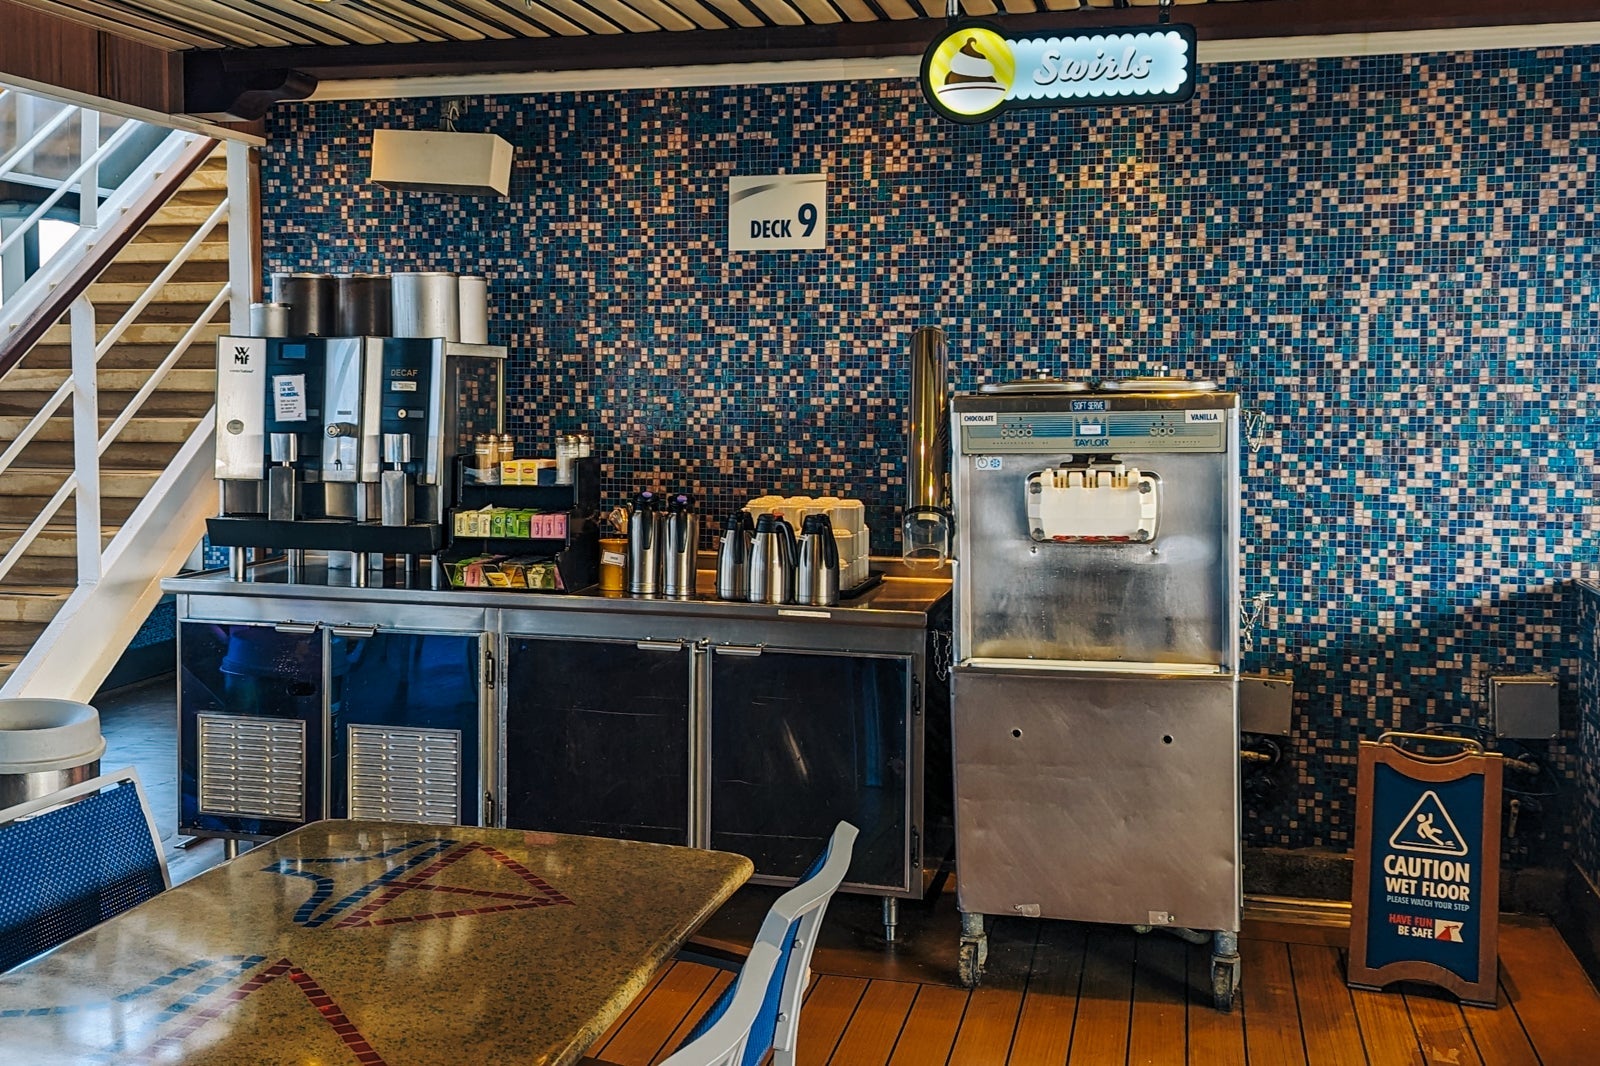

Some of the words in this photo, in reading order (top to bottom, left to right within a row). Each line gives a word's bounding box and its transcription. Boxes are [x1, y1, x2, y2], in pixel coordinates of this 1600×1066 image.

[1032, 45, 1153, 86] Swirls
[750, 219, 792, 239] DECK
[797, 202, 818, 238] 9
[390, 369, 418, 377] DECAF
[1073, 401, 1087, 410] SOFT
[1087, 401, 1104, 410] SERVE
[1190, 413, 1218, 421] VANILLA
[1073, 438, 1110, 447] TAYLOR
[1384, 854, 1470, 883] CAUTION
[1385, 876, 1418, 895] WET
[1422, 881, 1470, 901] FLOOR
[1386, 895, 1409, 904] PLEASE
[1410, 898, 1433, 907] WATCH
[1434, 901, 1452, 909] YOUR
[1389, 914, 1411, 925] HAVE
[1414, 916, 1433, 927] FUN
[1398, 926, 1409, 935] BE
[1411, 927, 1432, 938] SAFE
